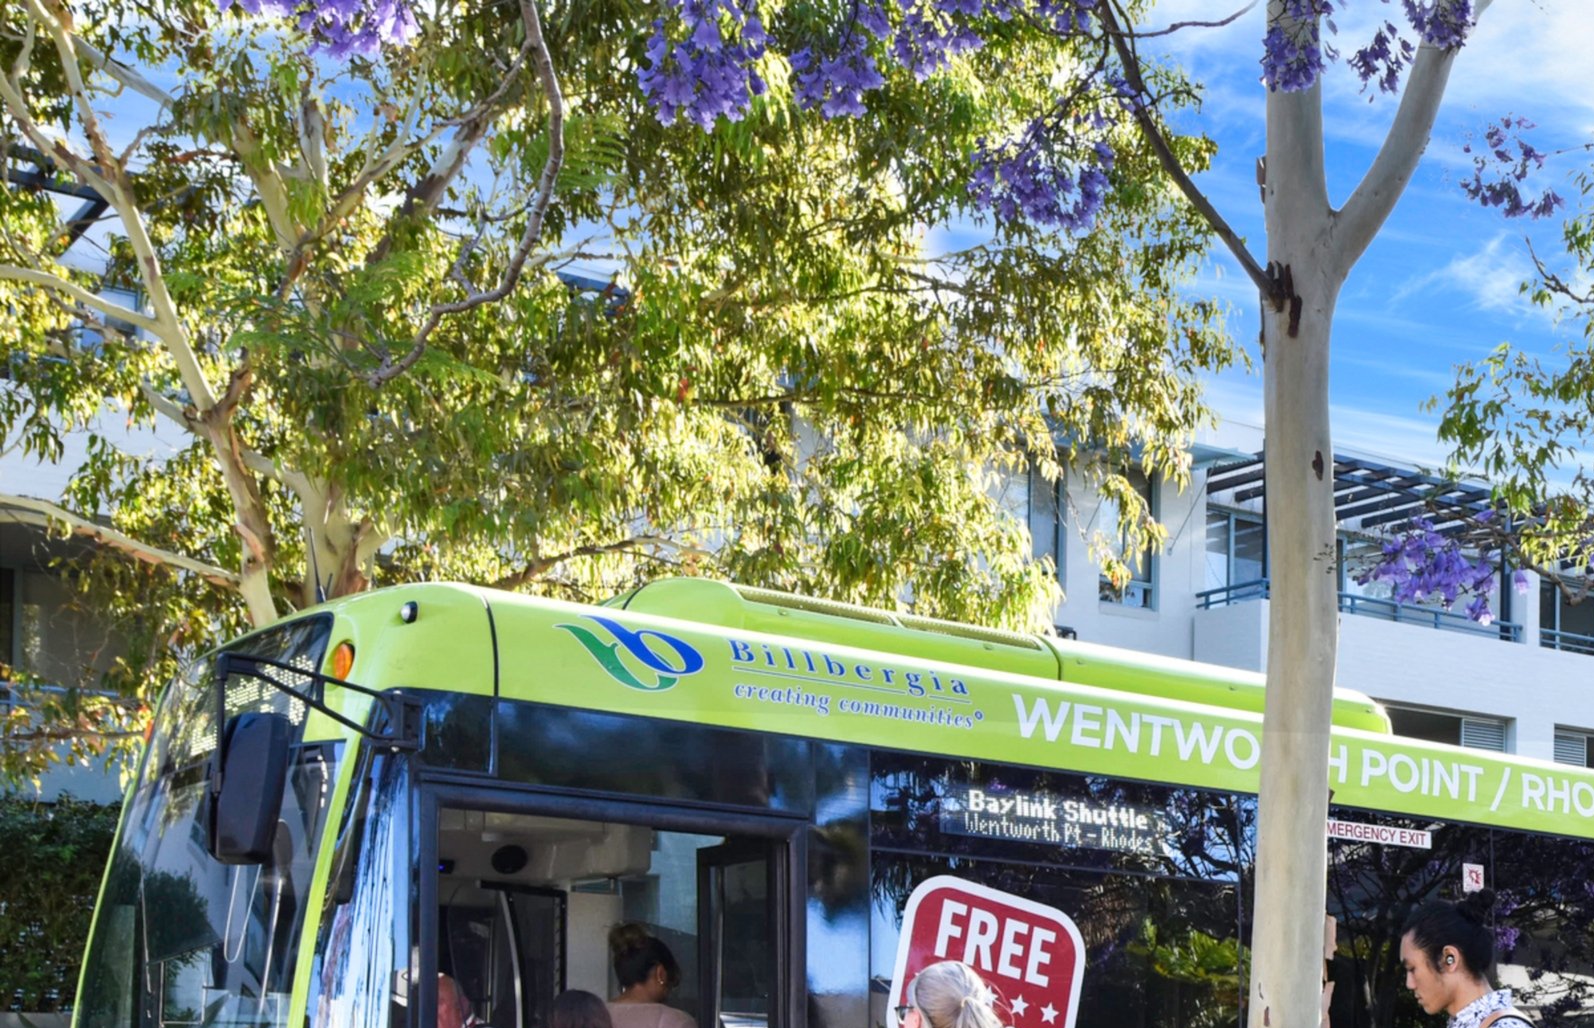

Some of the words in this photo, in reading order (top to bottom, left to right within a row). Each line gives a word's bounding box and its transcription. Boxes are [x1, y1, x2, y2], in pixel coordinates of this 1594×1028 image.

[728, 639, 969, 697] Billbergia
[734, 682, 830, 715] creating
[1012, 694, 1347, 784] WENTWOH
[1361, 748, 1484, 801] POINT
[1490, 767, 1511, 811] /
[968, 789, 1057, 820] Baylink
[1063, 800, 1148, 830] Shuttle
[964, 811, 1060, 842] Wentworth
[1064, 822, 1082, 844] Pt
[1101, 826, 1153, 850] Rhodes
[1327, 821, 1396, 843] MERGENCY
[1400, 831, 1426, 846] EXIT
[934, 898, 1056, 988] FREE
